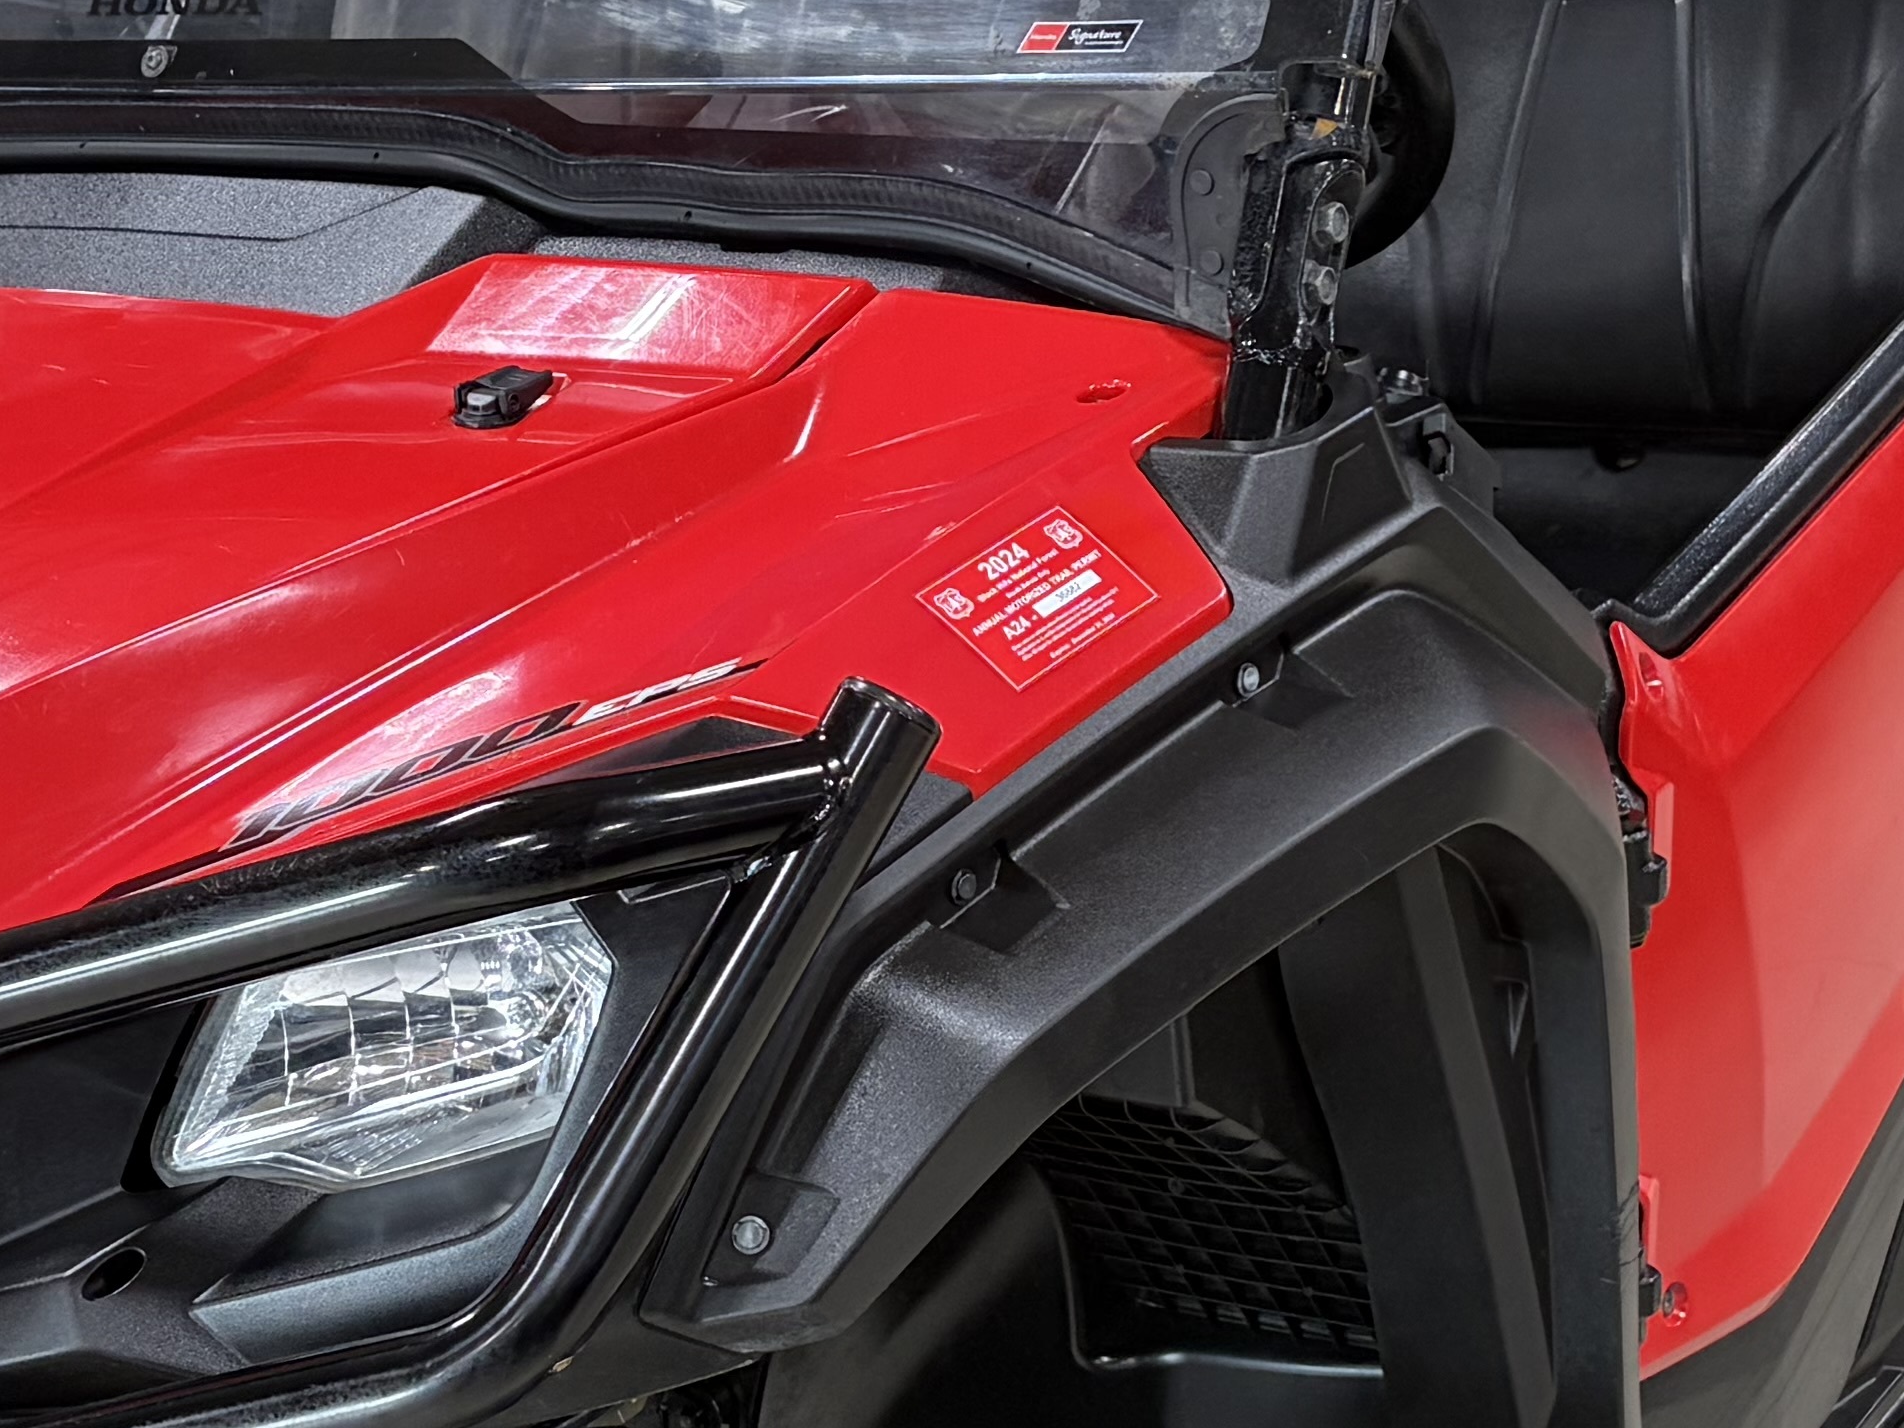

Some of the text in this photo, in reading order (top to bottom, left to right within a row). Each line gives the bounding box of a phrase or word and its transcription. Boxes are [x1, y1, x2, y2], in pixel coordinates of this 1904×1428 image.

[1068, 28, 1122, 45] Signature
[977, 542, 1030, 580] 2024
[972, 611, 1007, 636] ANNUAL
[1048, 568, 1074, 585] TRAIL
[1070, 549, 1102, 571] PERMIT
[1002, 615, 1032, 641] A24
[218, 657, 743, 852] 1000 EPS
